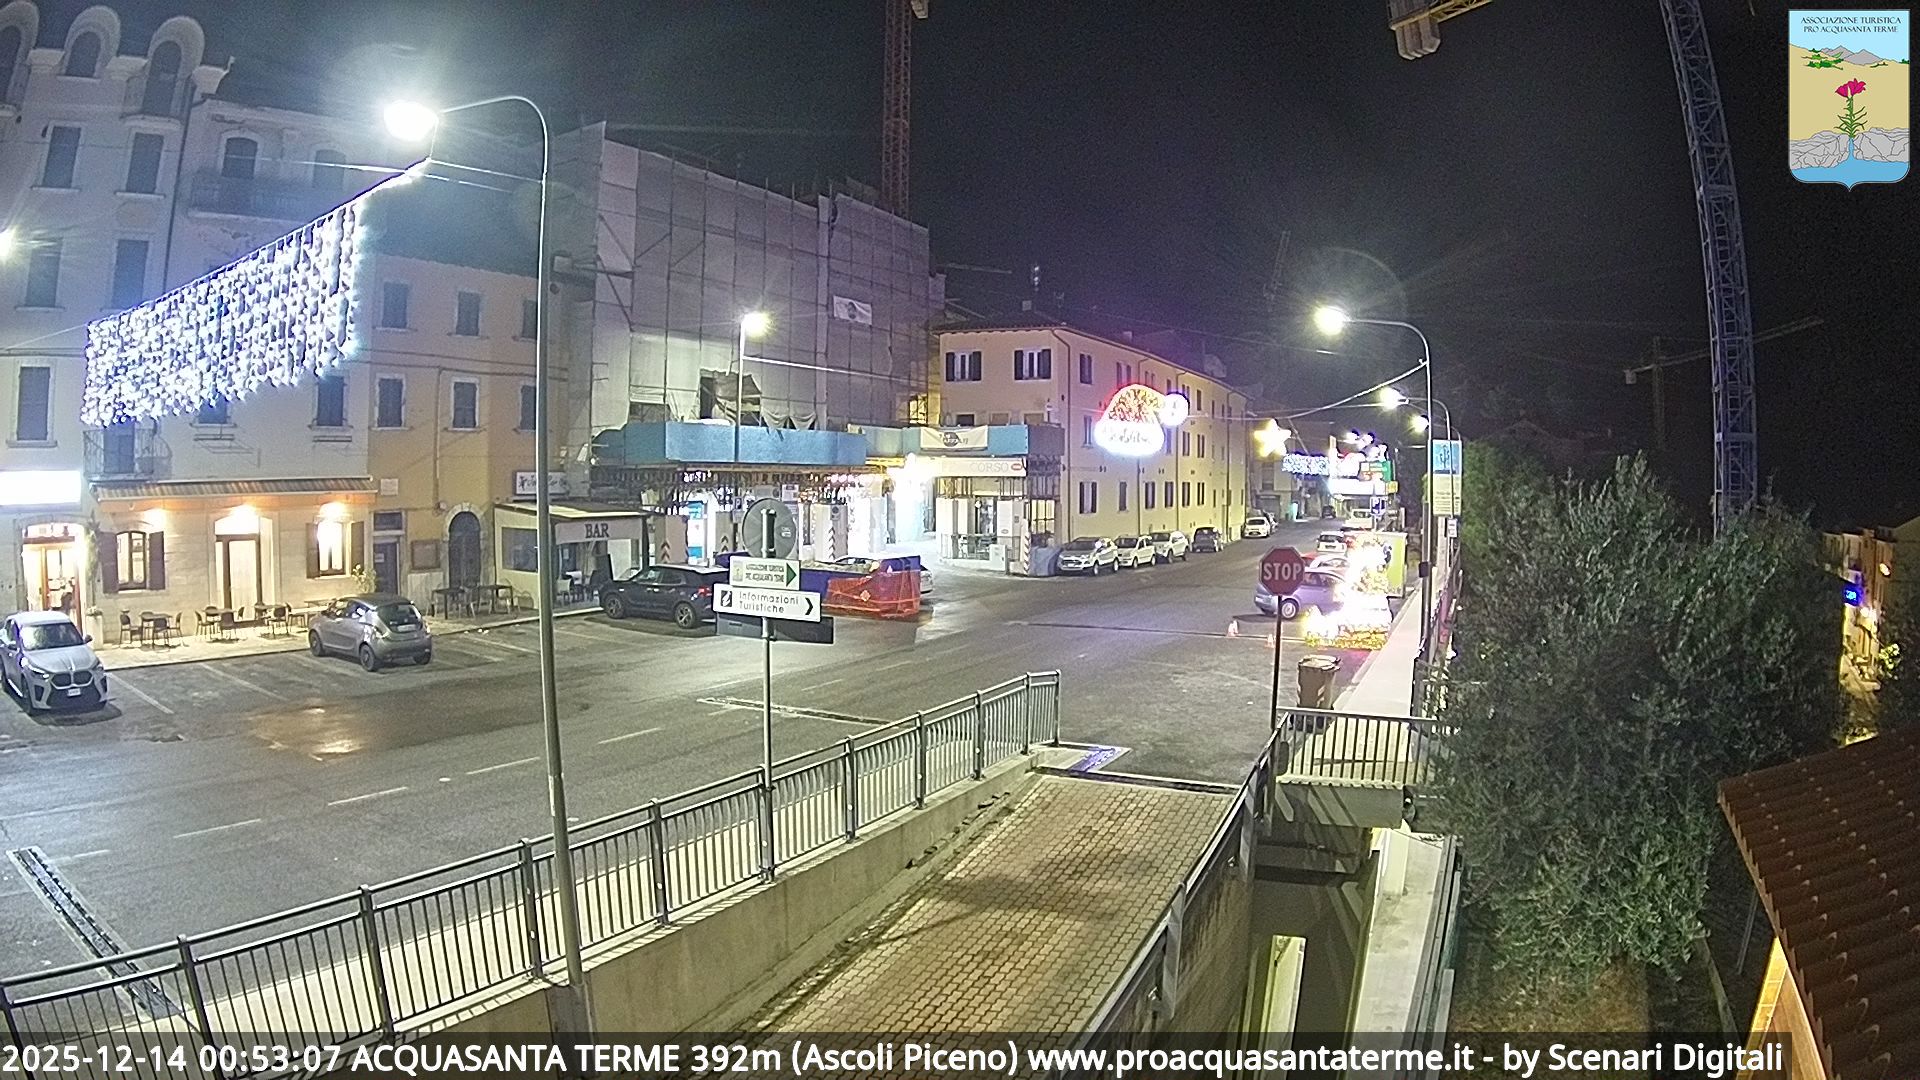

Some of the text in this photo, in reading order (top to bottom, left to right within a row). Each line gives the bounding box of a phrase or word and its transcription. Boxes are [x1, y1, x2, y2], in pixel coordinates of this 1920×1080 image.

[584, 522, 610, 539] BAR
[1263, 562, 1302, 581] STOP
[739, 591, 799, 605] Informazioni
[739, 600, 785, 613] Turistiche
